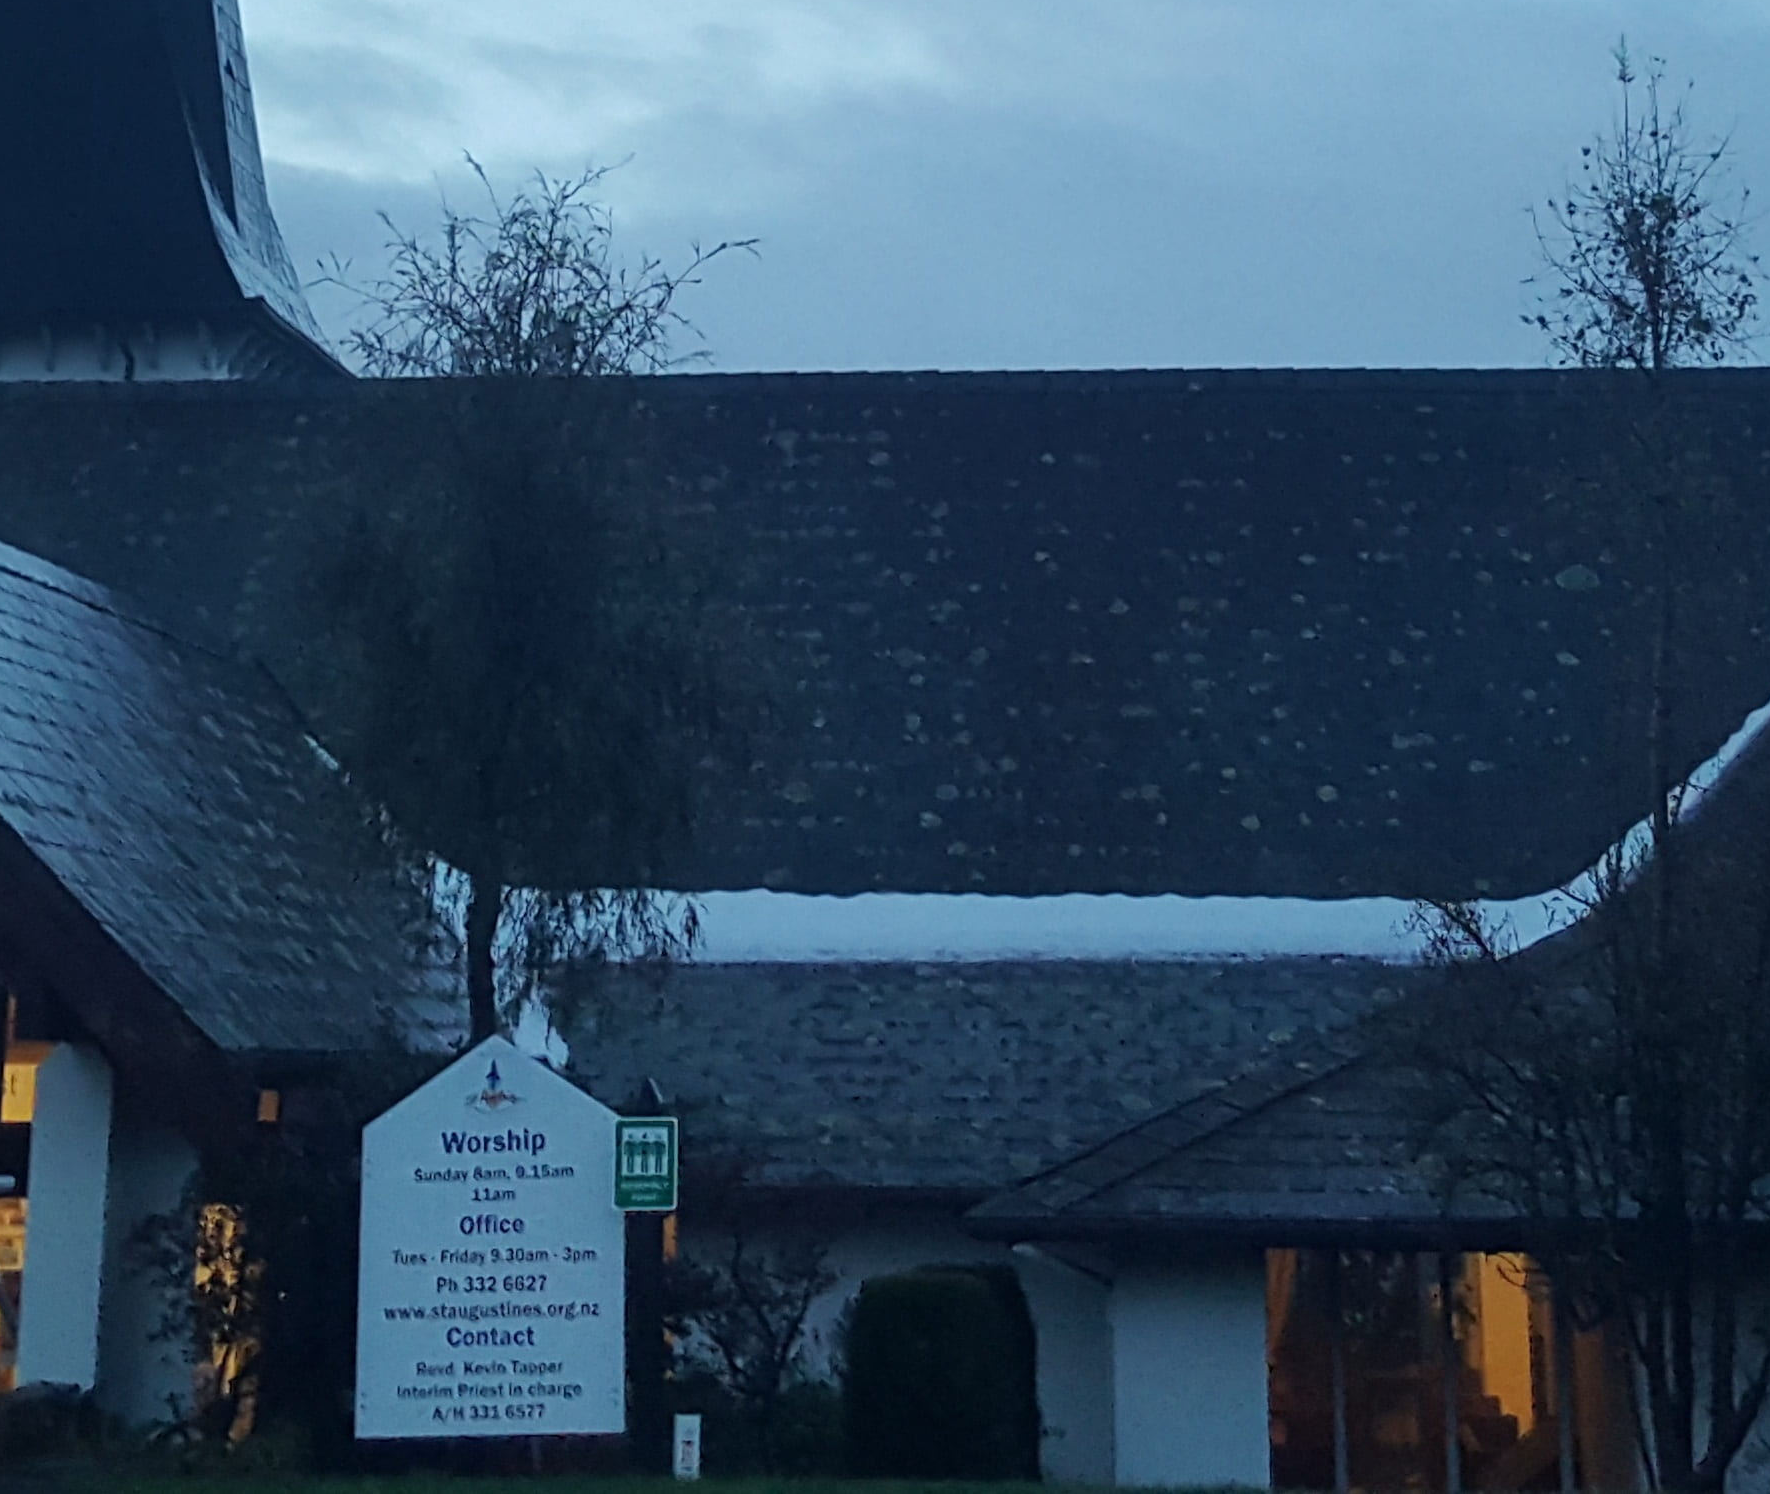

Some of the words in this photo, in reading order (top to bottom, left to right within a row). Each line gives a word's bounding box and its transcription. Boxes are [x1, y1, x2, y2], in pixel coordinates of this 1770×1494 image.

[441, 1128, 546, 1155] Worship
[413, 1167, 468, 1182] Sunday
[471, 1187, 516, 1202] 11am
[459, 1214, 525, 1235] Office
[392, 1249, 427, 1265] Tues
[440, 1249, 485, 1266] Friday
[490, 1247, 549, 1264] 9.30am
[562, 1246, 597, 1264] 3pm
[436, 1277, 458, 1293] Ph
[464, 1275, 497, 1293] 332
[503, 1274, 548, 1292] 6627
[384, 1301, 600, 1321] www.staugustines.org.nz
[446, 1326, 535, 1348] Contact
[463, 1360, 507, 1375] Kevin
[397, 1384, 453, 1399] Interim
[458, 1382, 504, 1398] Priest
[509, 1382, 523, 1396] in
[527, 1380, 582, 1399] charge
[469, 1404, 500, 1420] 331
